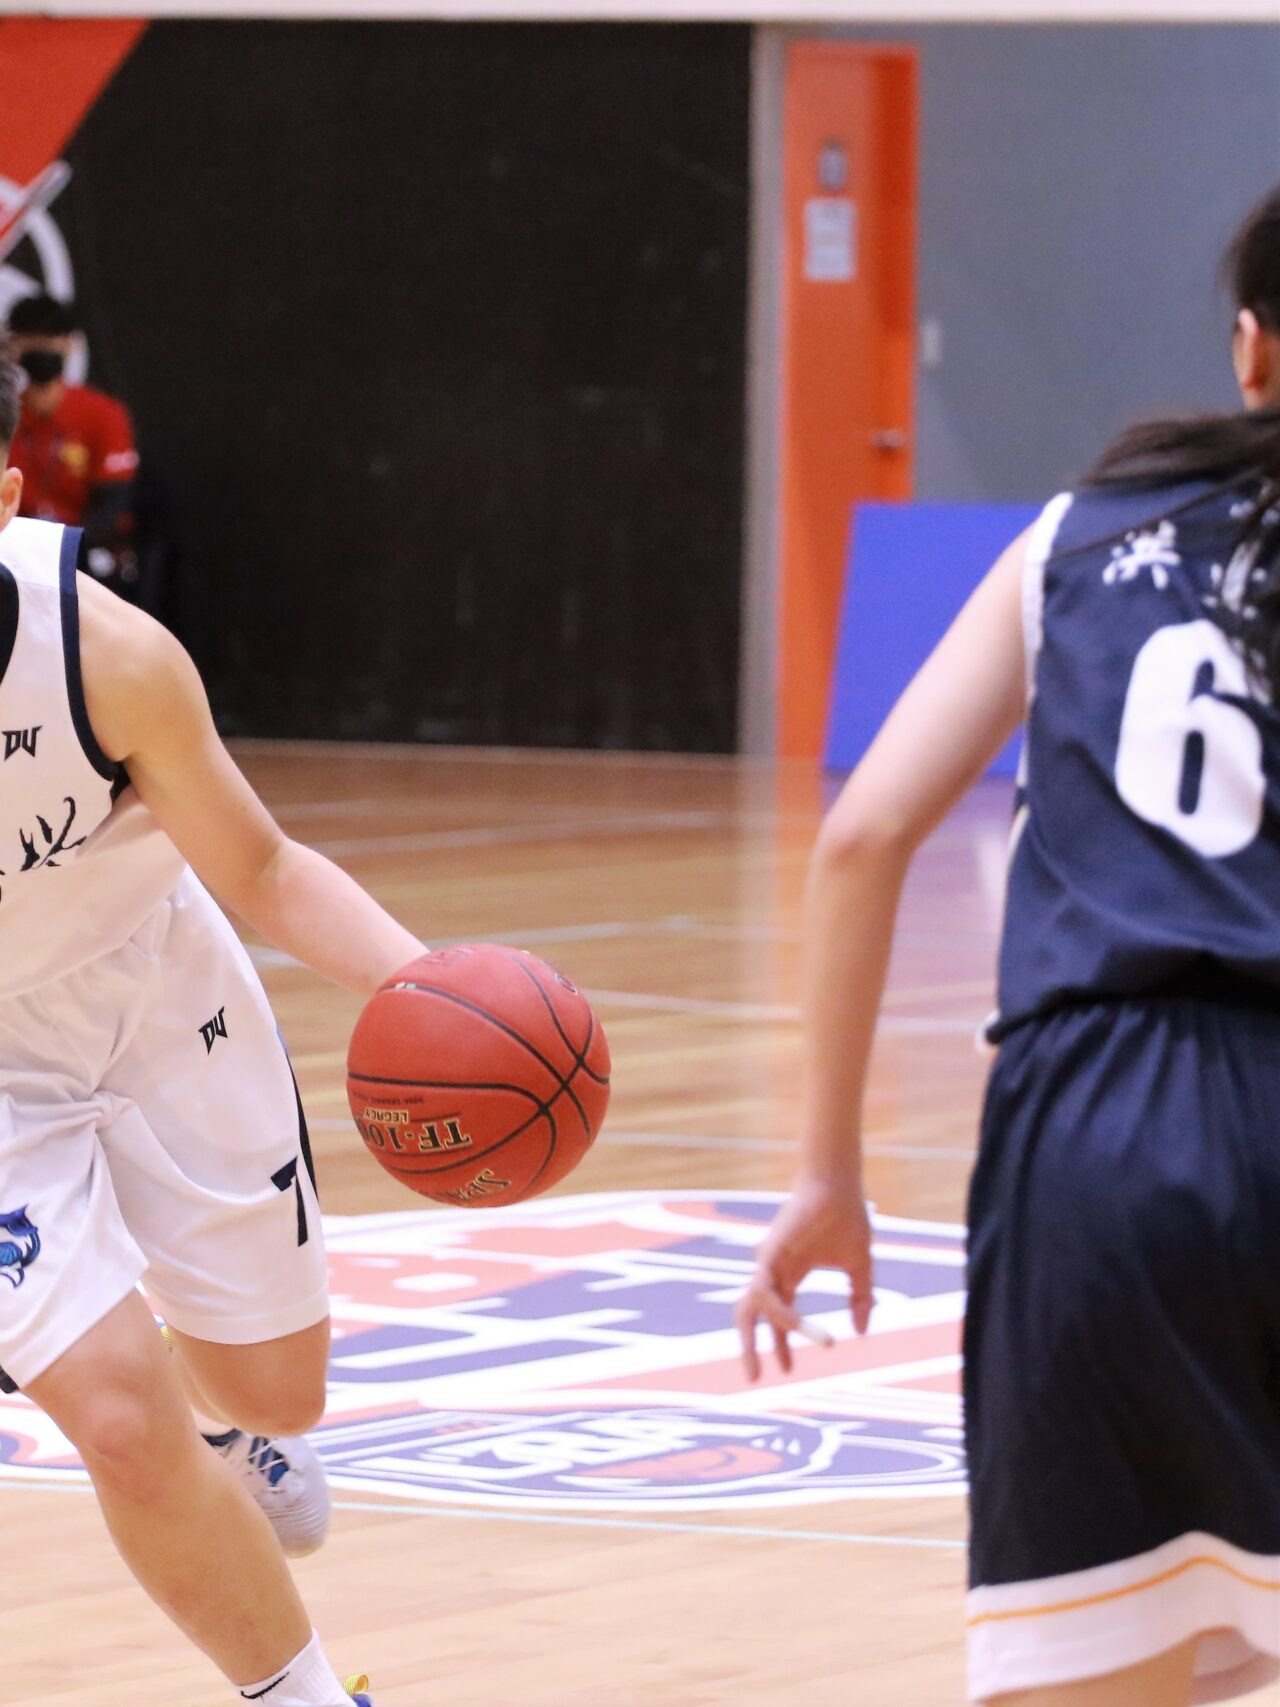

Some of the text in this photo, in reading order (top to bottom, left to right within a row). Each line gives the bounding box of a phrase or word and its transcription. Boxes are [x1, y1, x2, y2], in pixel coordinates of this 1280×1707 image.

[1115, 618, 1266, 858] 6
[365, 1108, 408, 1122] LEGACY
[270, 1156, 309, 1247] 7
